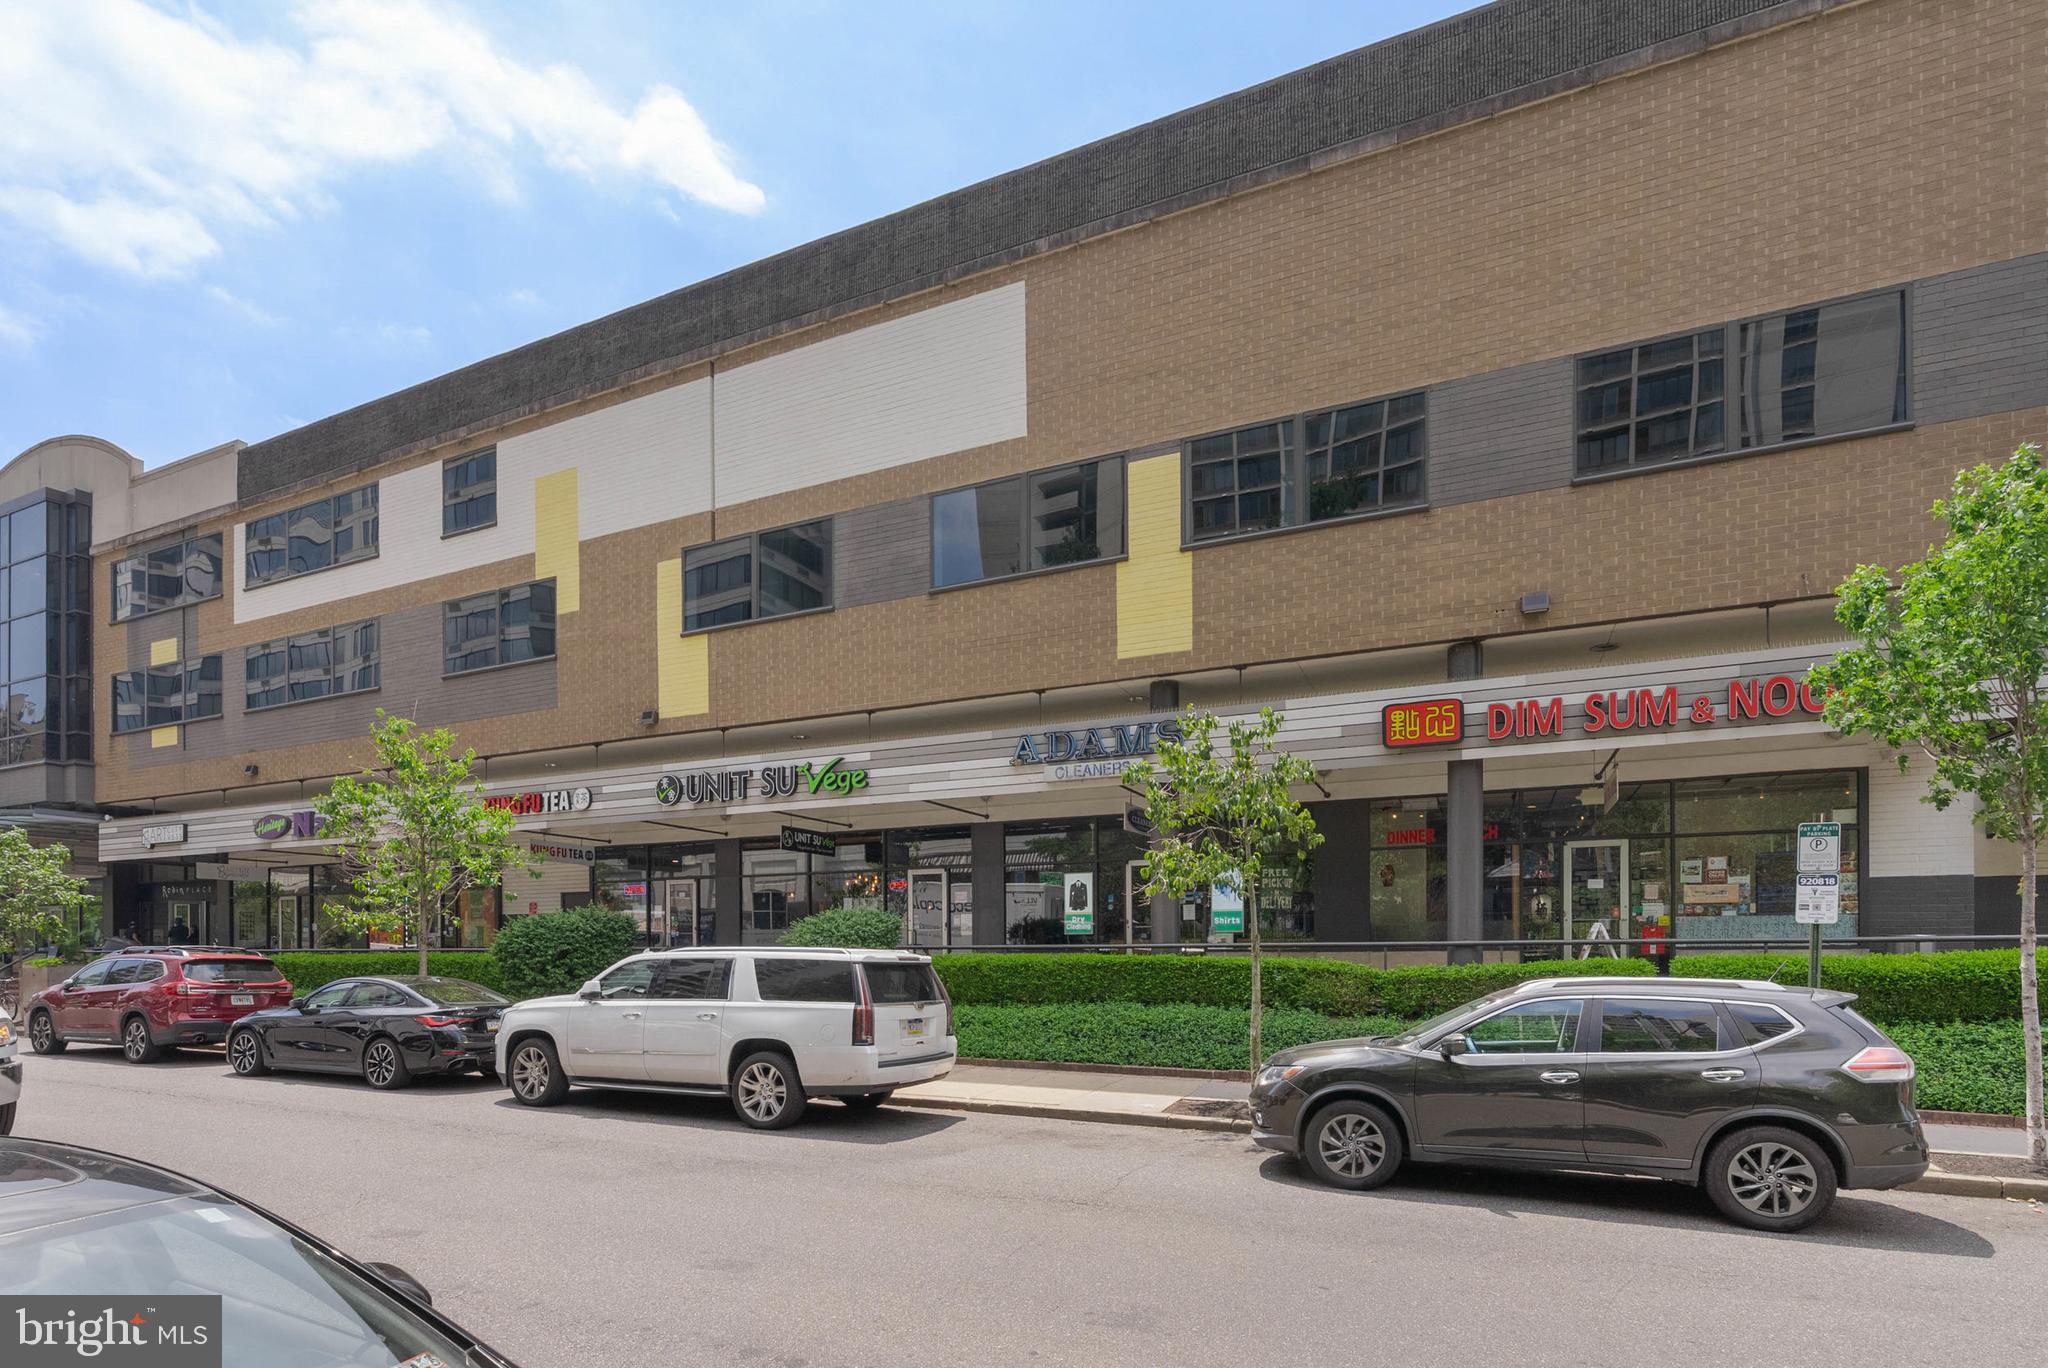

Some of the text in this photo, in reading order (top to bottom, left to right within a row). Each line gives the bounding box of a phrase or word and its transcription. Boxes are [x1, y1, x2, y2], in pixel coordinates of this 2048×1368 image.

[1487, 697, 1563, 740] DIM
[1584, 685, 1678, 732] SUM
[1691, 696, 1716, 724] &
[686, 757, 869, 804] UNIT SU Vege
[523, 792, 542, 813] FU
[542, 790, 571, 812] TEA
[794, 832, 811, 844] UNIT
[812, 835, 821, 845] SU
[1387, 828, 1436, 845] DINNER
[1815, 839, 1822, 849] P
[556, 847, 567, 858] FU
[568, 849, 584, 860] TEA
[1262, 868, 1289, 877] FREE
[1800, 877, 1836, 885] 920818
[1261, 896, 1293, 909] DELIVERY
[1214, 917, 1241, 925] Shirts
